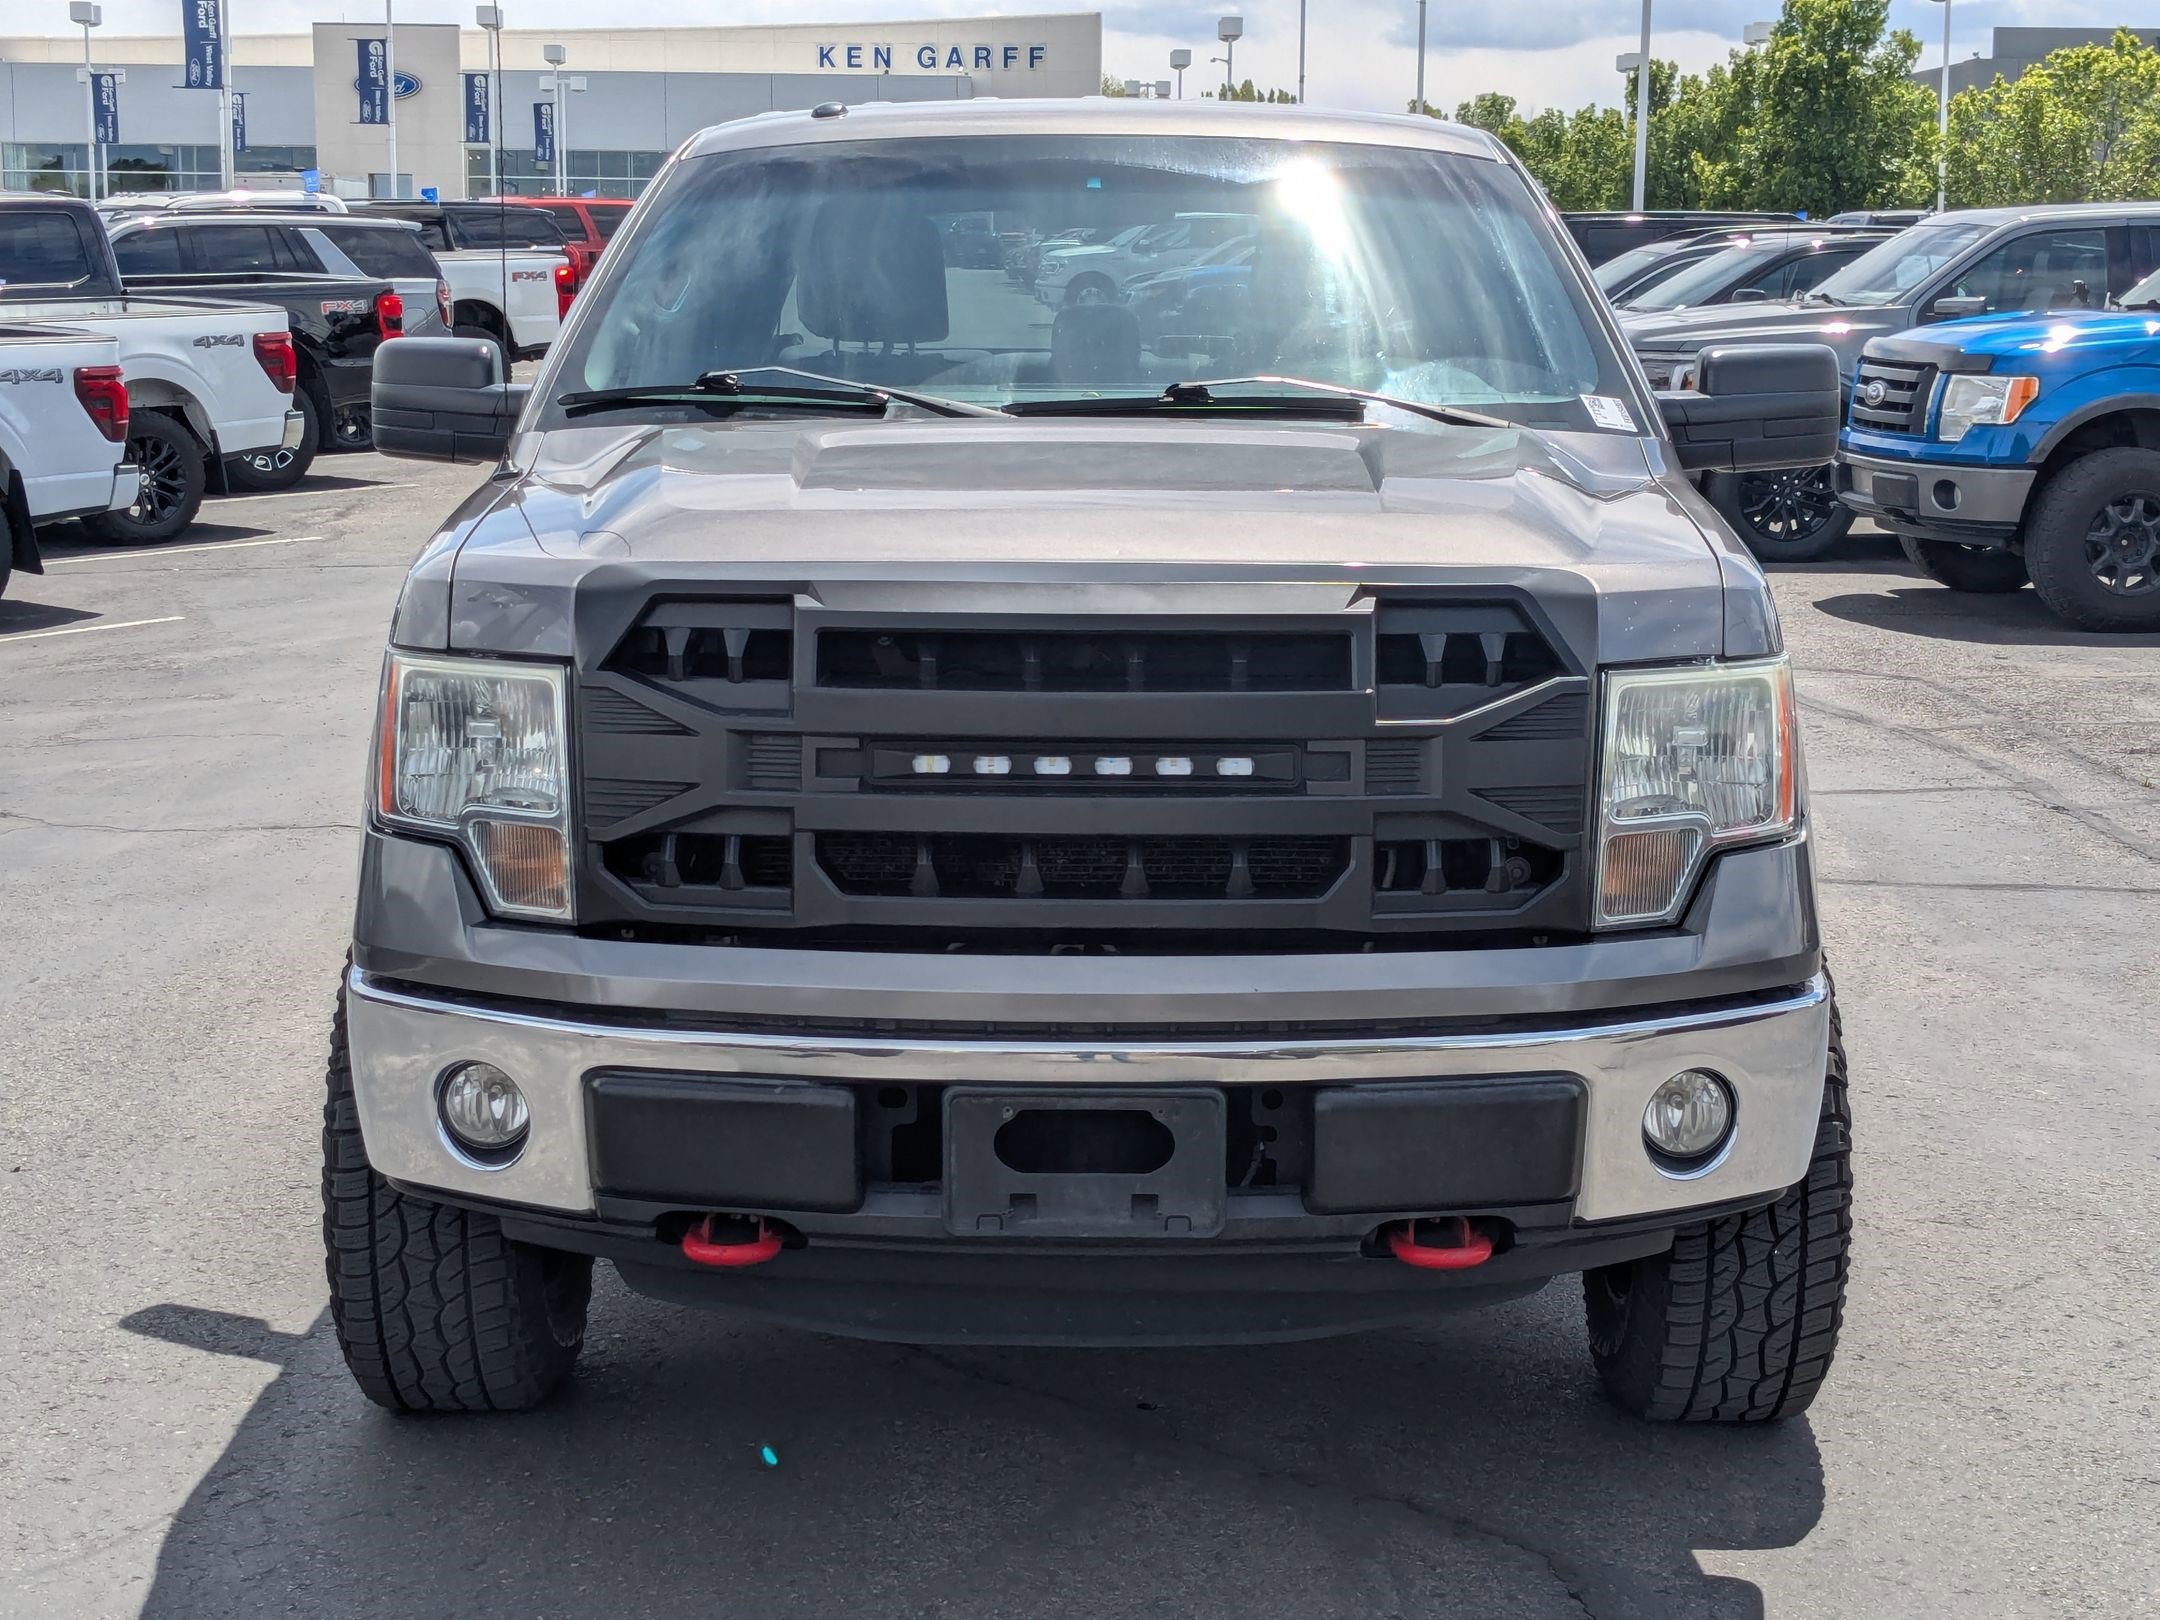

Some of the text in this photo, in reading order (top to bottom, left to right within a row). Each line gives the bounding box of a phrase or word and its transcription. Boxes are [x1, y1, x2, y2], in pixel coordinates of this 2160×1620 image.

[197, 1, 208, 28] Ford
[208, 1, 216, 17] Ken
[818, 45, 1045, 69] KEN GARFF
[369, 56, 378, 78] Ford
[512, 271, 547, 282] FX4
[321, 299, 369, 315] FX4
